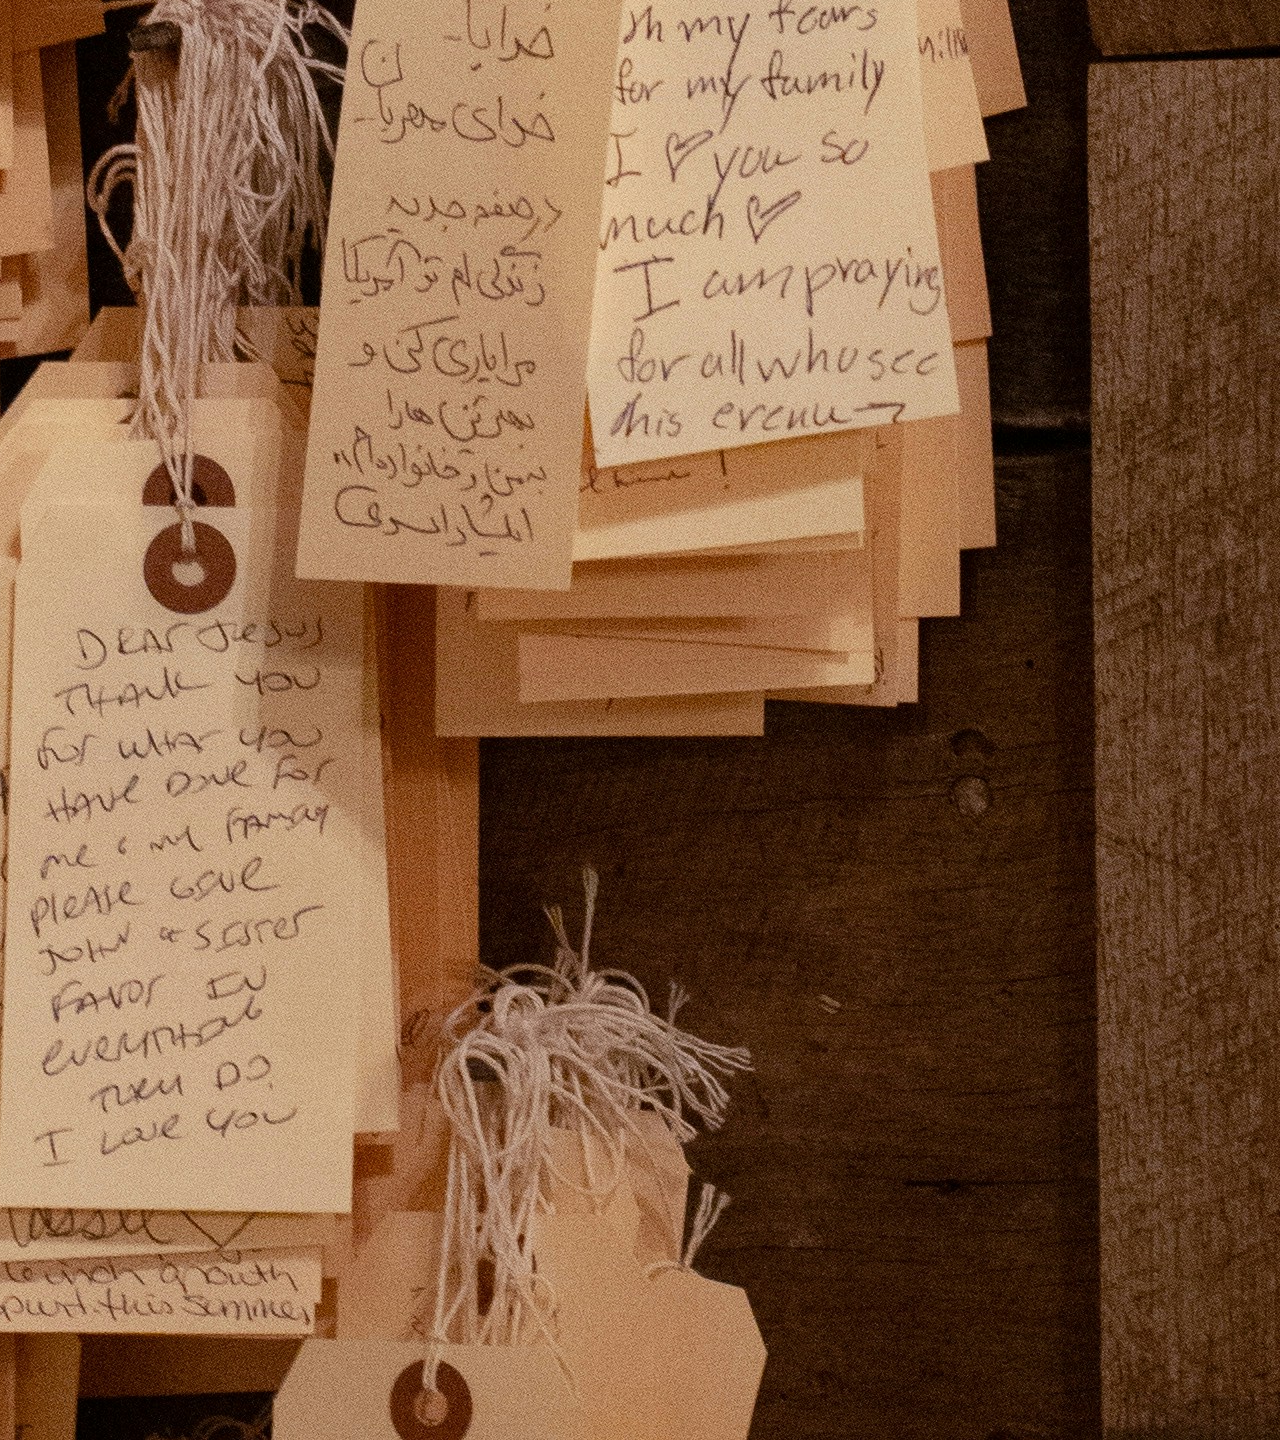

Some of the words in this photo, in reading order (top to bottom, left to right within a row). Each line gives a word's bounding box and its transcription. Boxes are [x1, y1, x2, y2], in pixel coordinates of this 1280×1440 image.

[616, 58, 662, 105] for
[686, 70, 752, 134] my
[760, 48, 886, 116] family
[614, 254, 680, 322] I
[702, 265, 794, 300] am
[804, 246, 939, 317] praying
[618, 326, 690, 384] for
[700, 329, 746, 386] all
[756, 328, 859, 384] who
